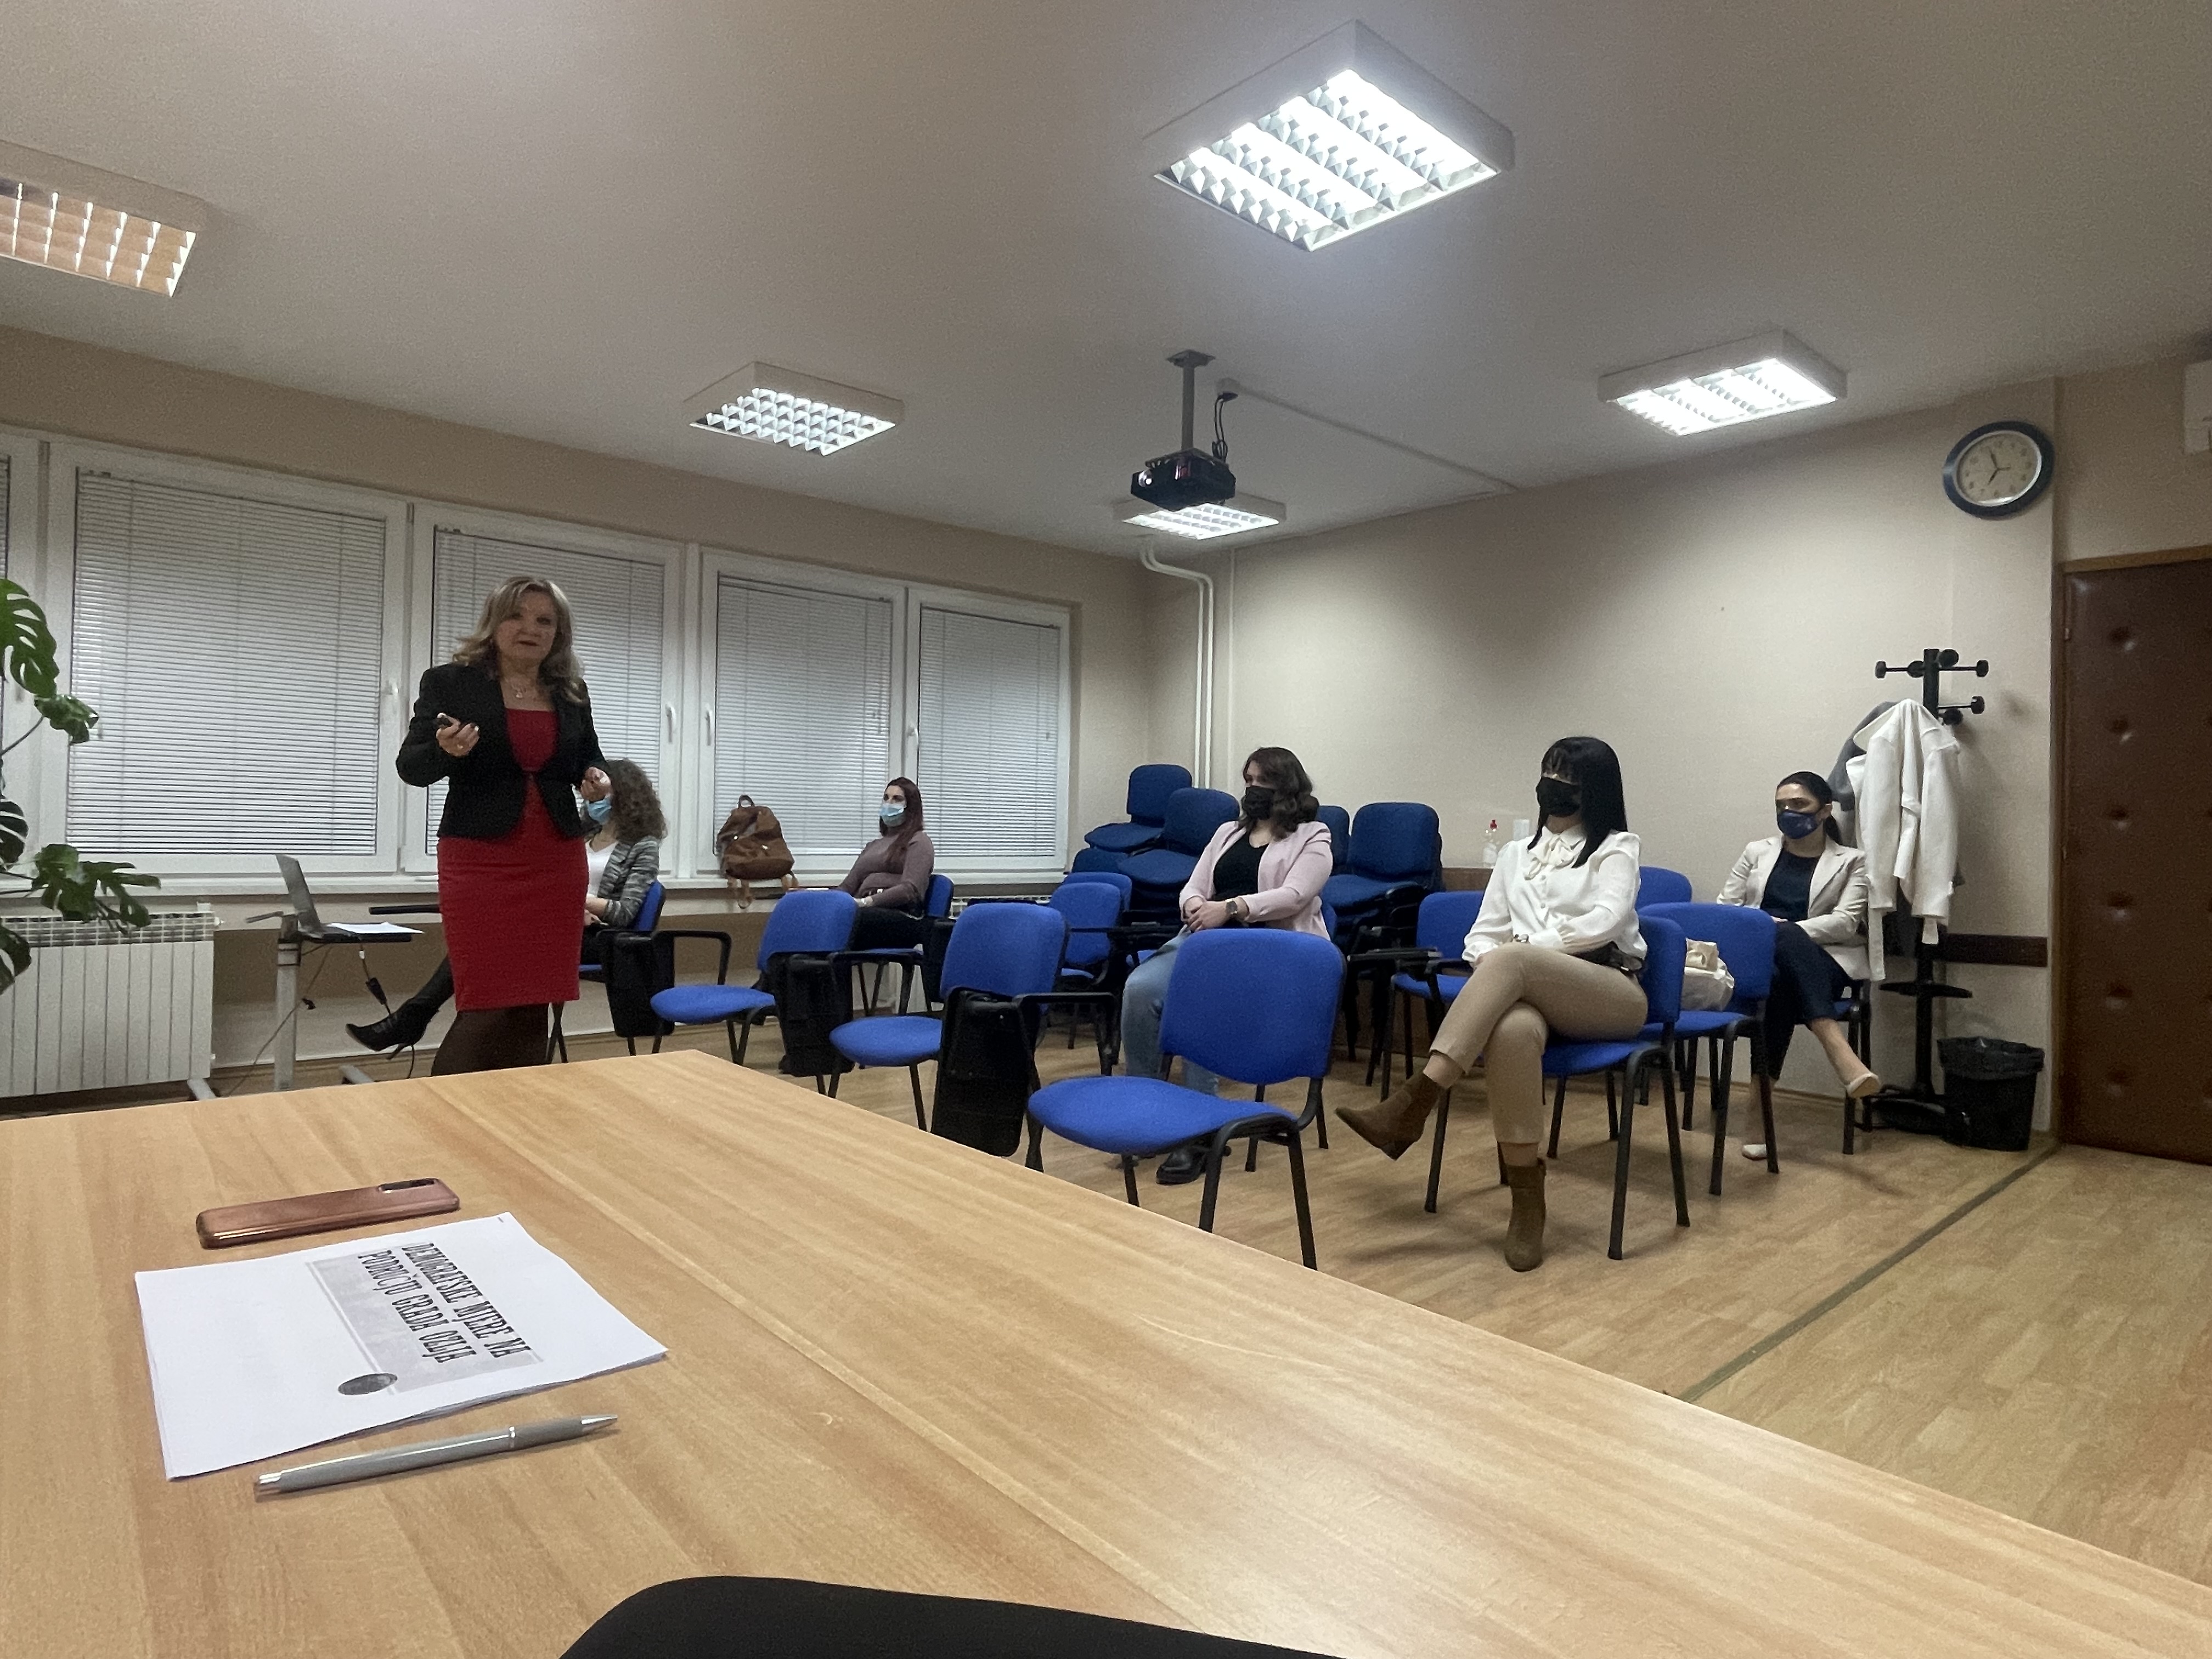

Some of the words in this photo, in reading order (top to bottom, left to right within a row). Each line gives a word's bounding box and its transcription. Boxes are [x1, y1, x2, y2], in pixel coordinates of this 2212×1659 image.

[358, 1250, 423, 1295] PODRUČJU
[391, 1294, 450, 1332] GRADA
[451, 1301, 515, 1339] MJERE
[483, 1338, 531, 1358] NA
[418, 1330, 477, 1364] OZLJA
